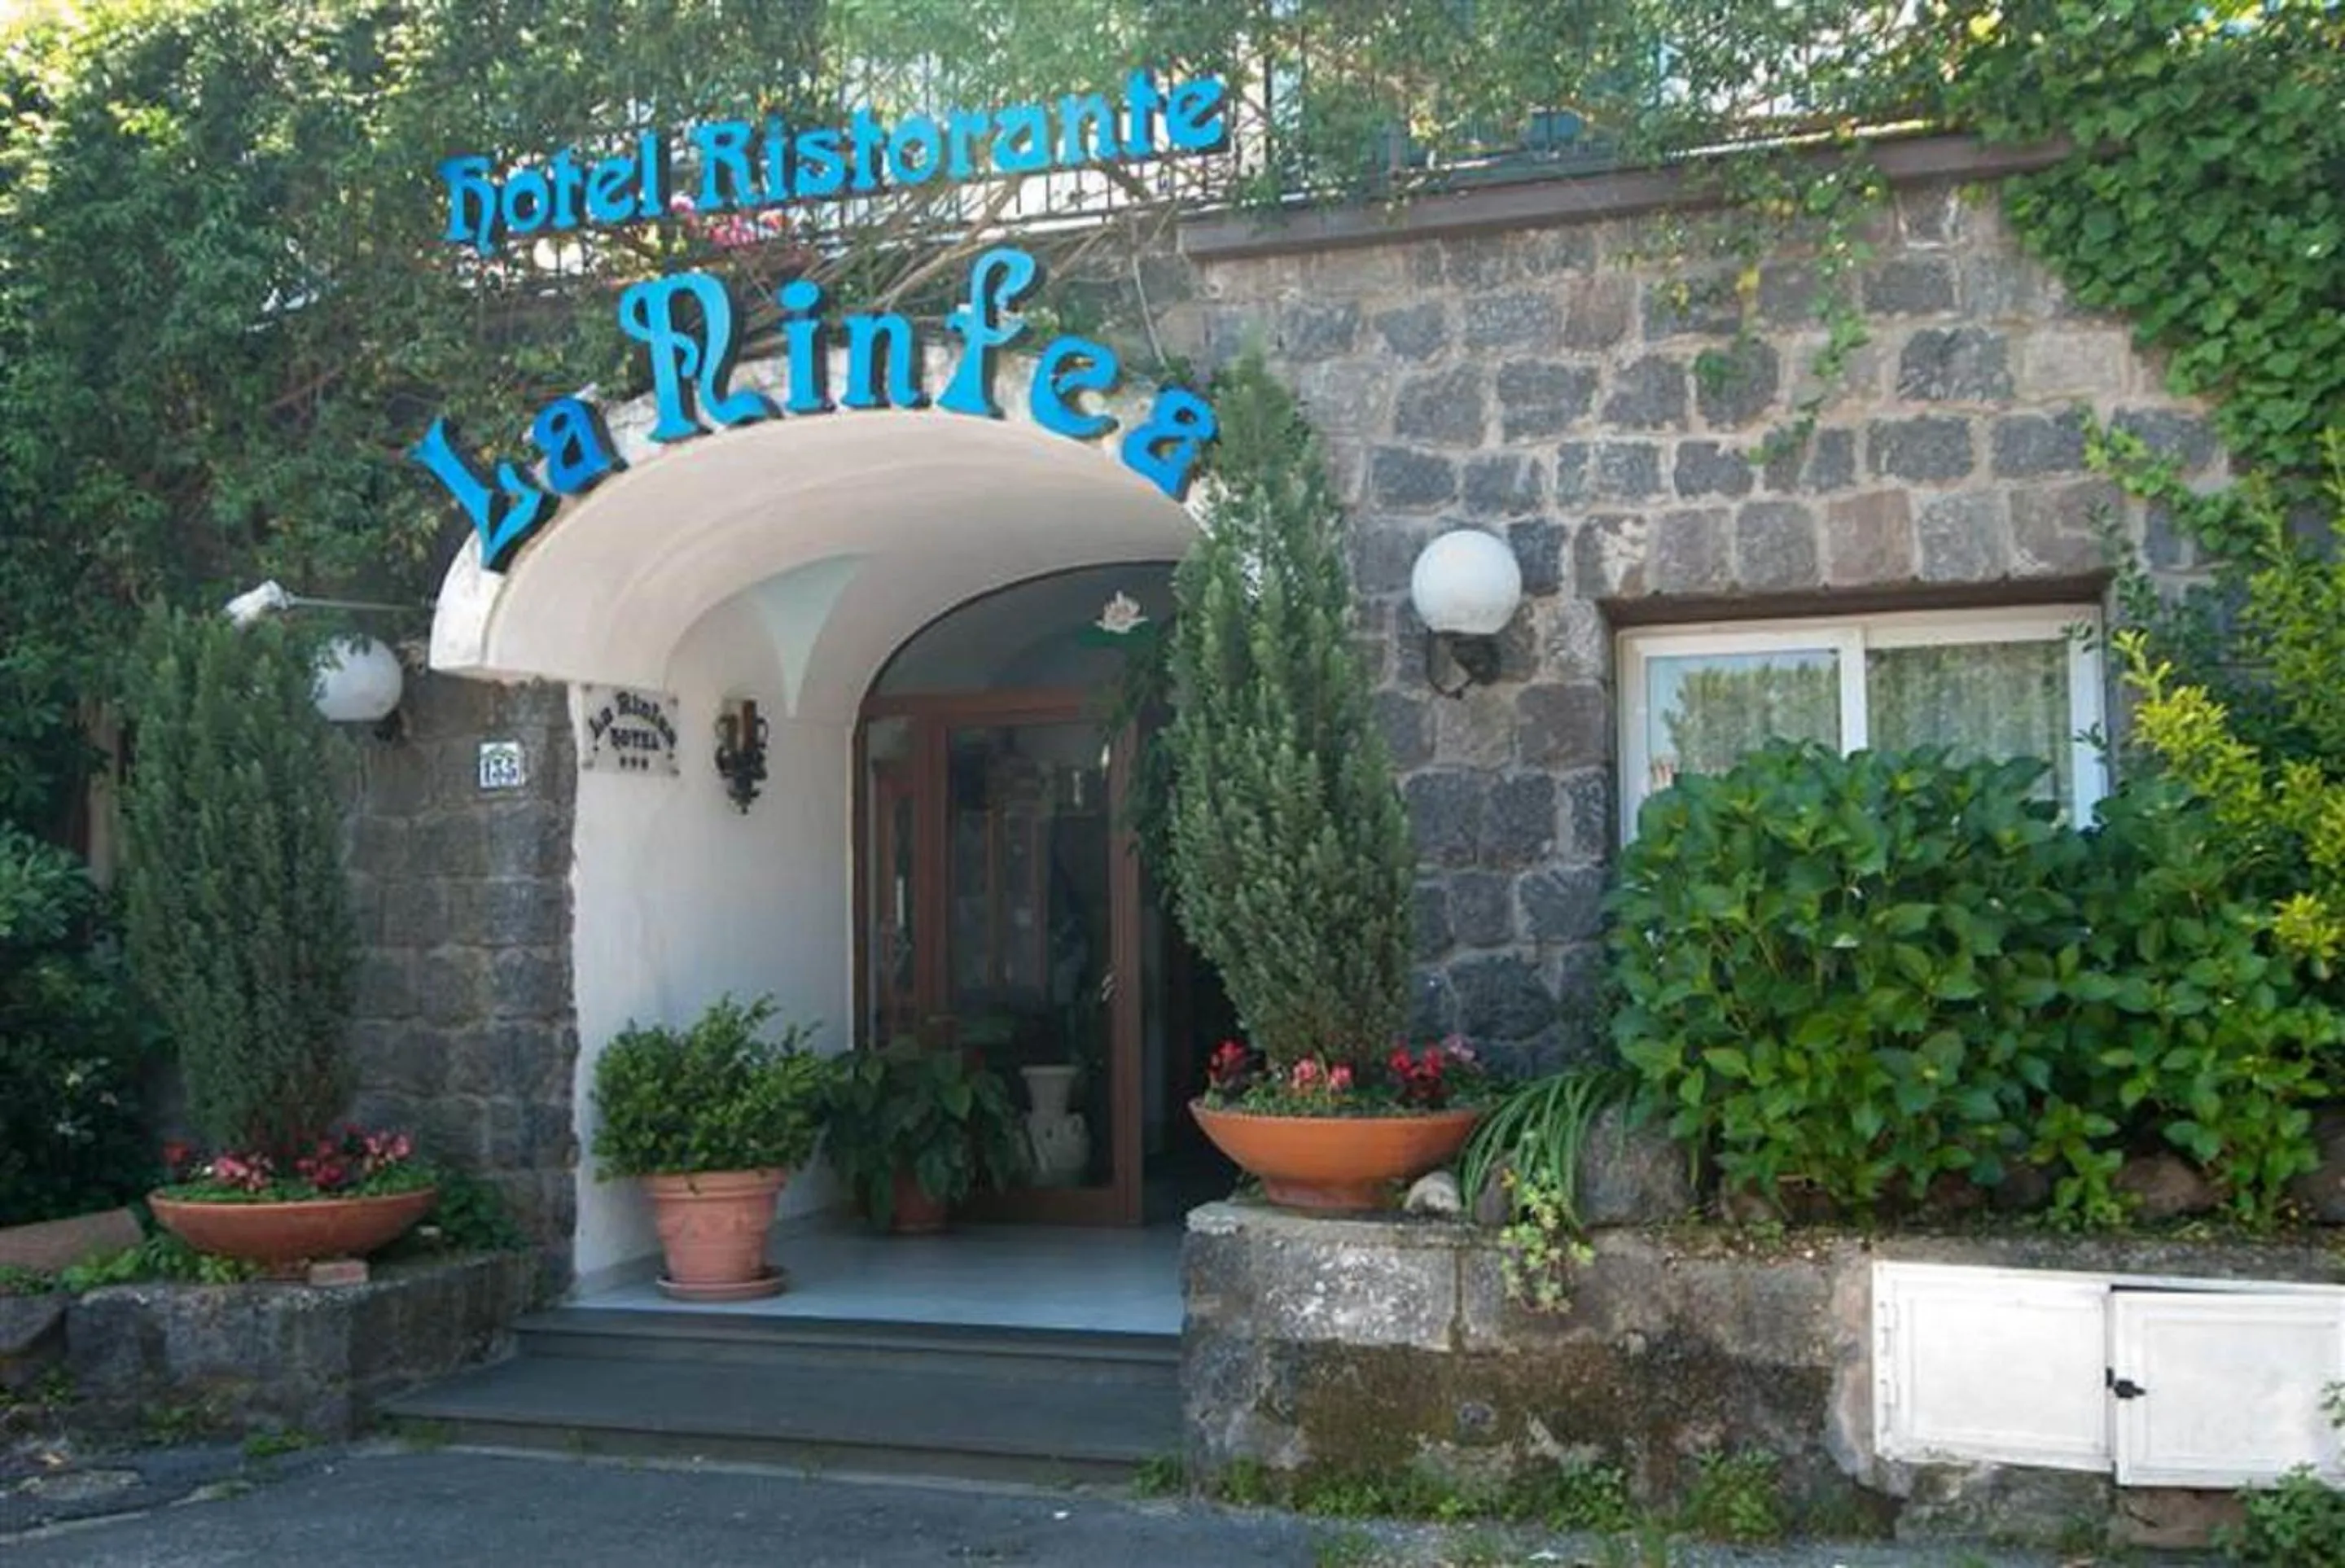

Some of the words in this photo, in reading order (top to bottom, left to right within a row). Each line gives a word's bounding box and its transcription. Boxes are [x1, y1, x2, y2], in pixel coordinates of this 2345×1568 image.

[690, 68, 1226, 212] Ristorante
[409, 396, 612, 570] La
[619, 246, 1219, 497] Ninfea
